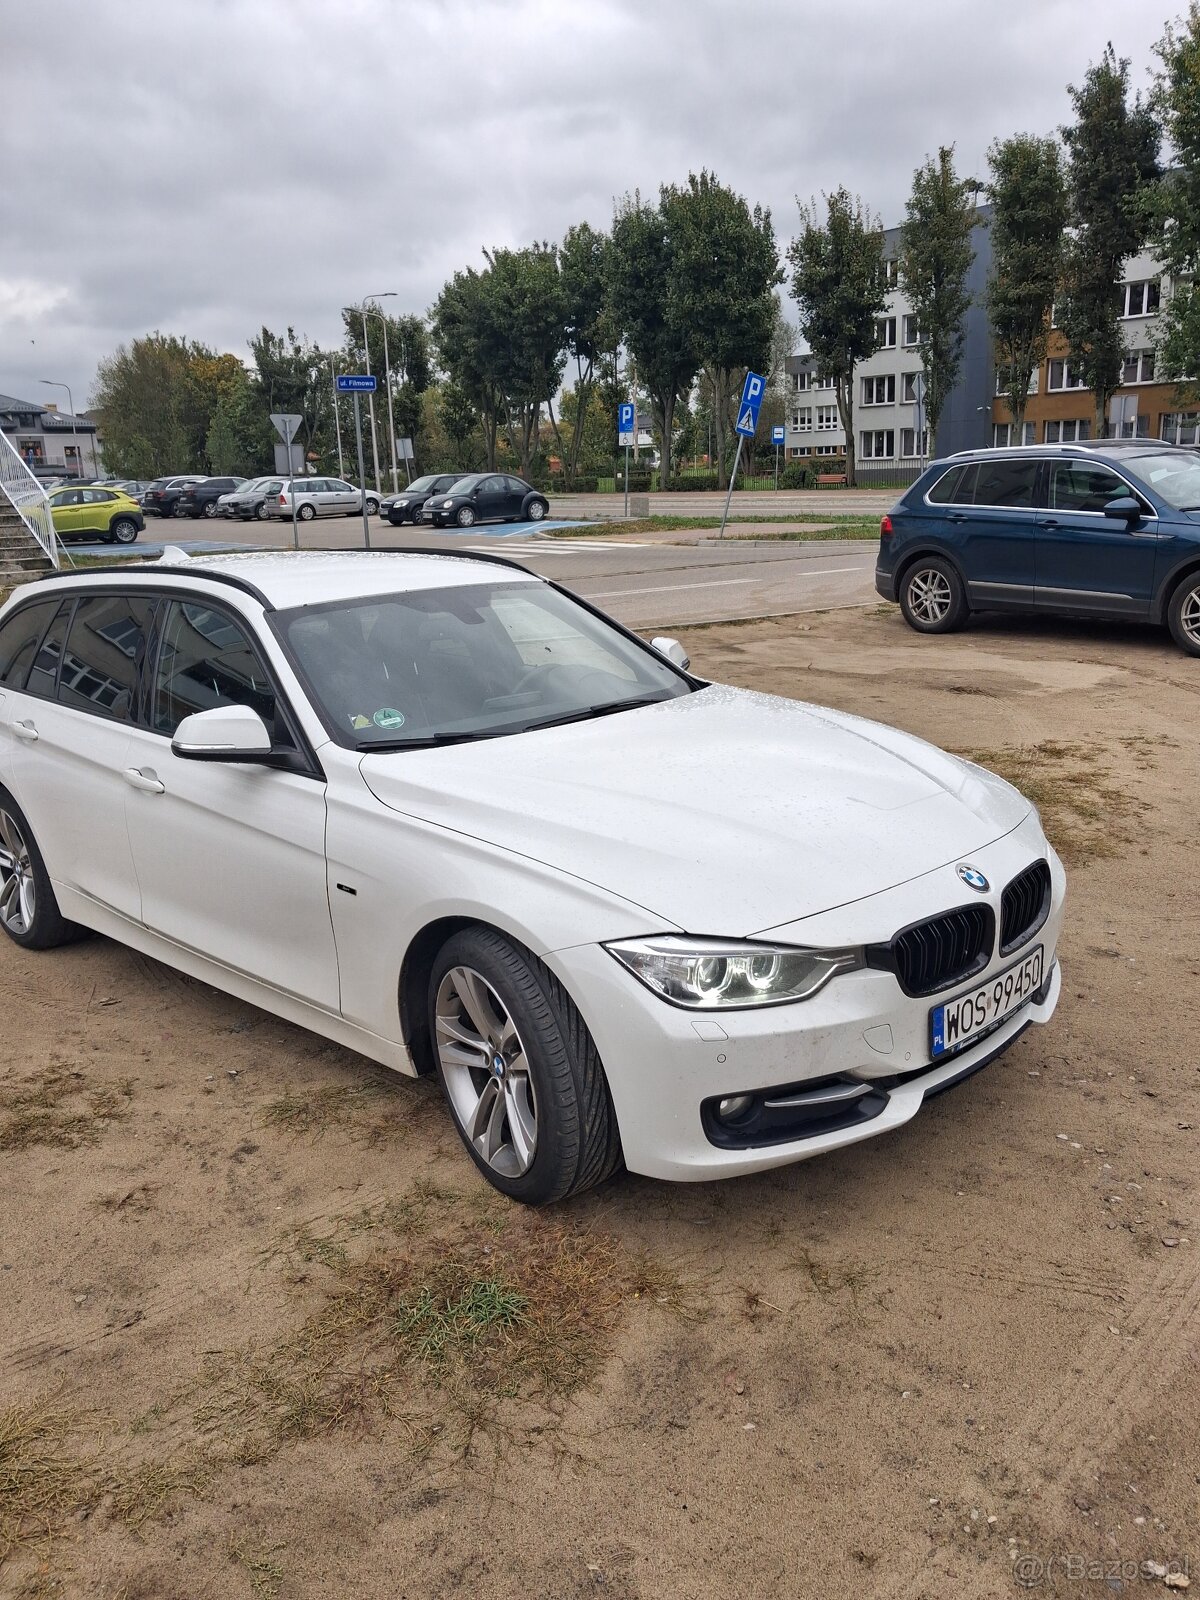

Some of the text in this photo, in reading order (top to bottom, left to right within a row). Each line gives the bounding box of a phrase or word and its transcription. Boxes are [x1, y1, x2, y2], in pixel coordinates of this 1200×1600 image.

[747, 377, 761, 400] P
[622, 406, 632, 424] P
[947, 991, 987, 1043] WOS
[993, 954, 1040, 1017] 99450
[934, 1035, 943, 1046] PL
